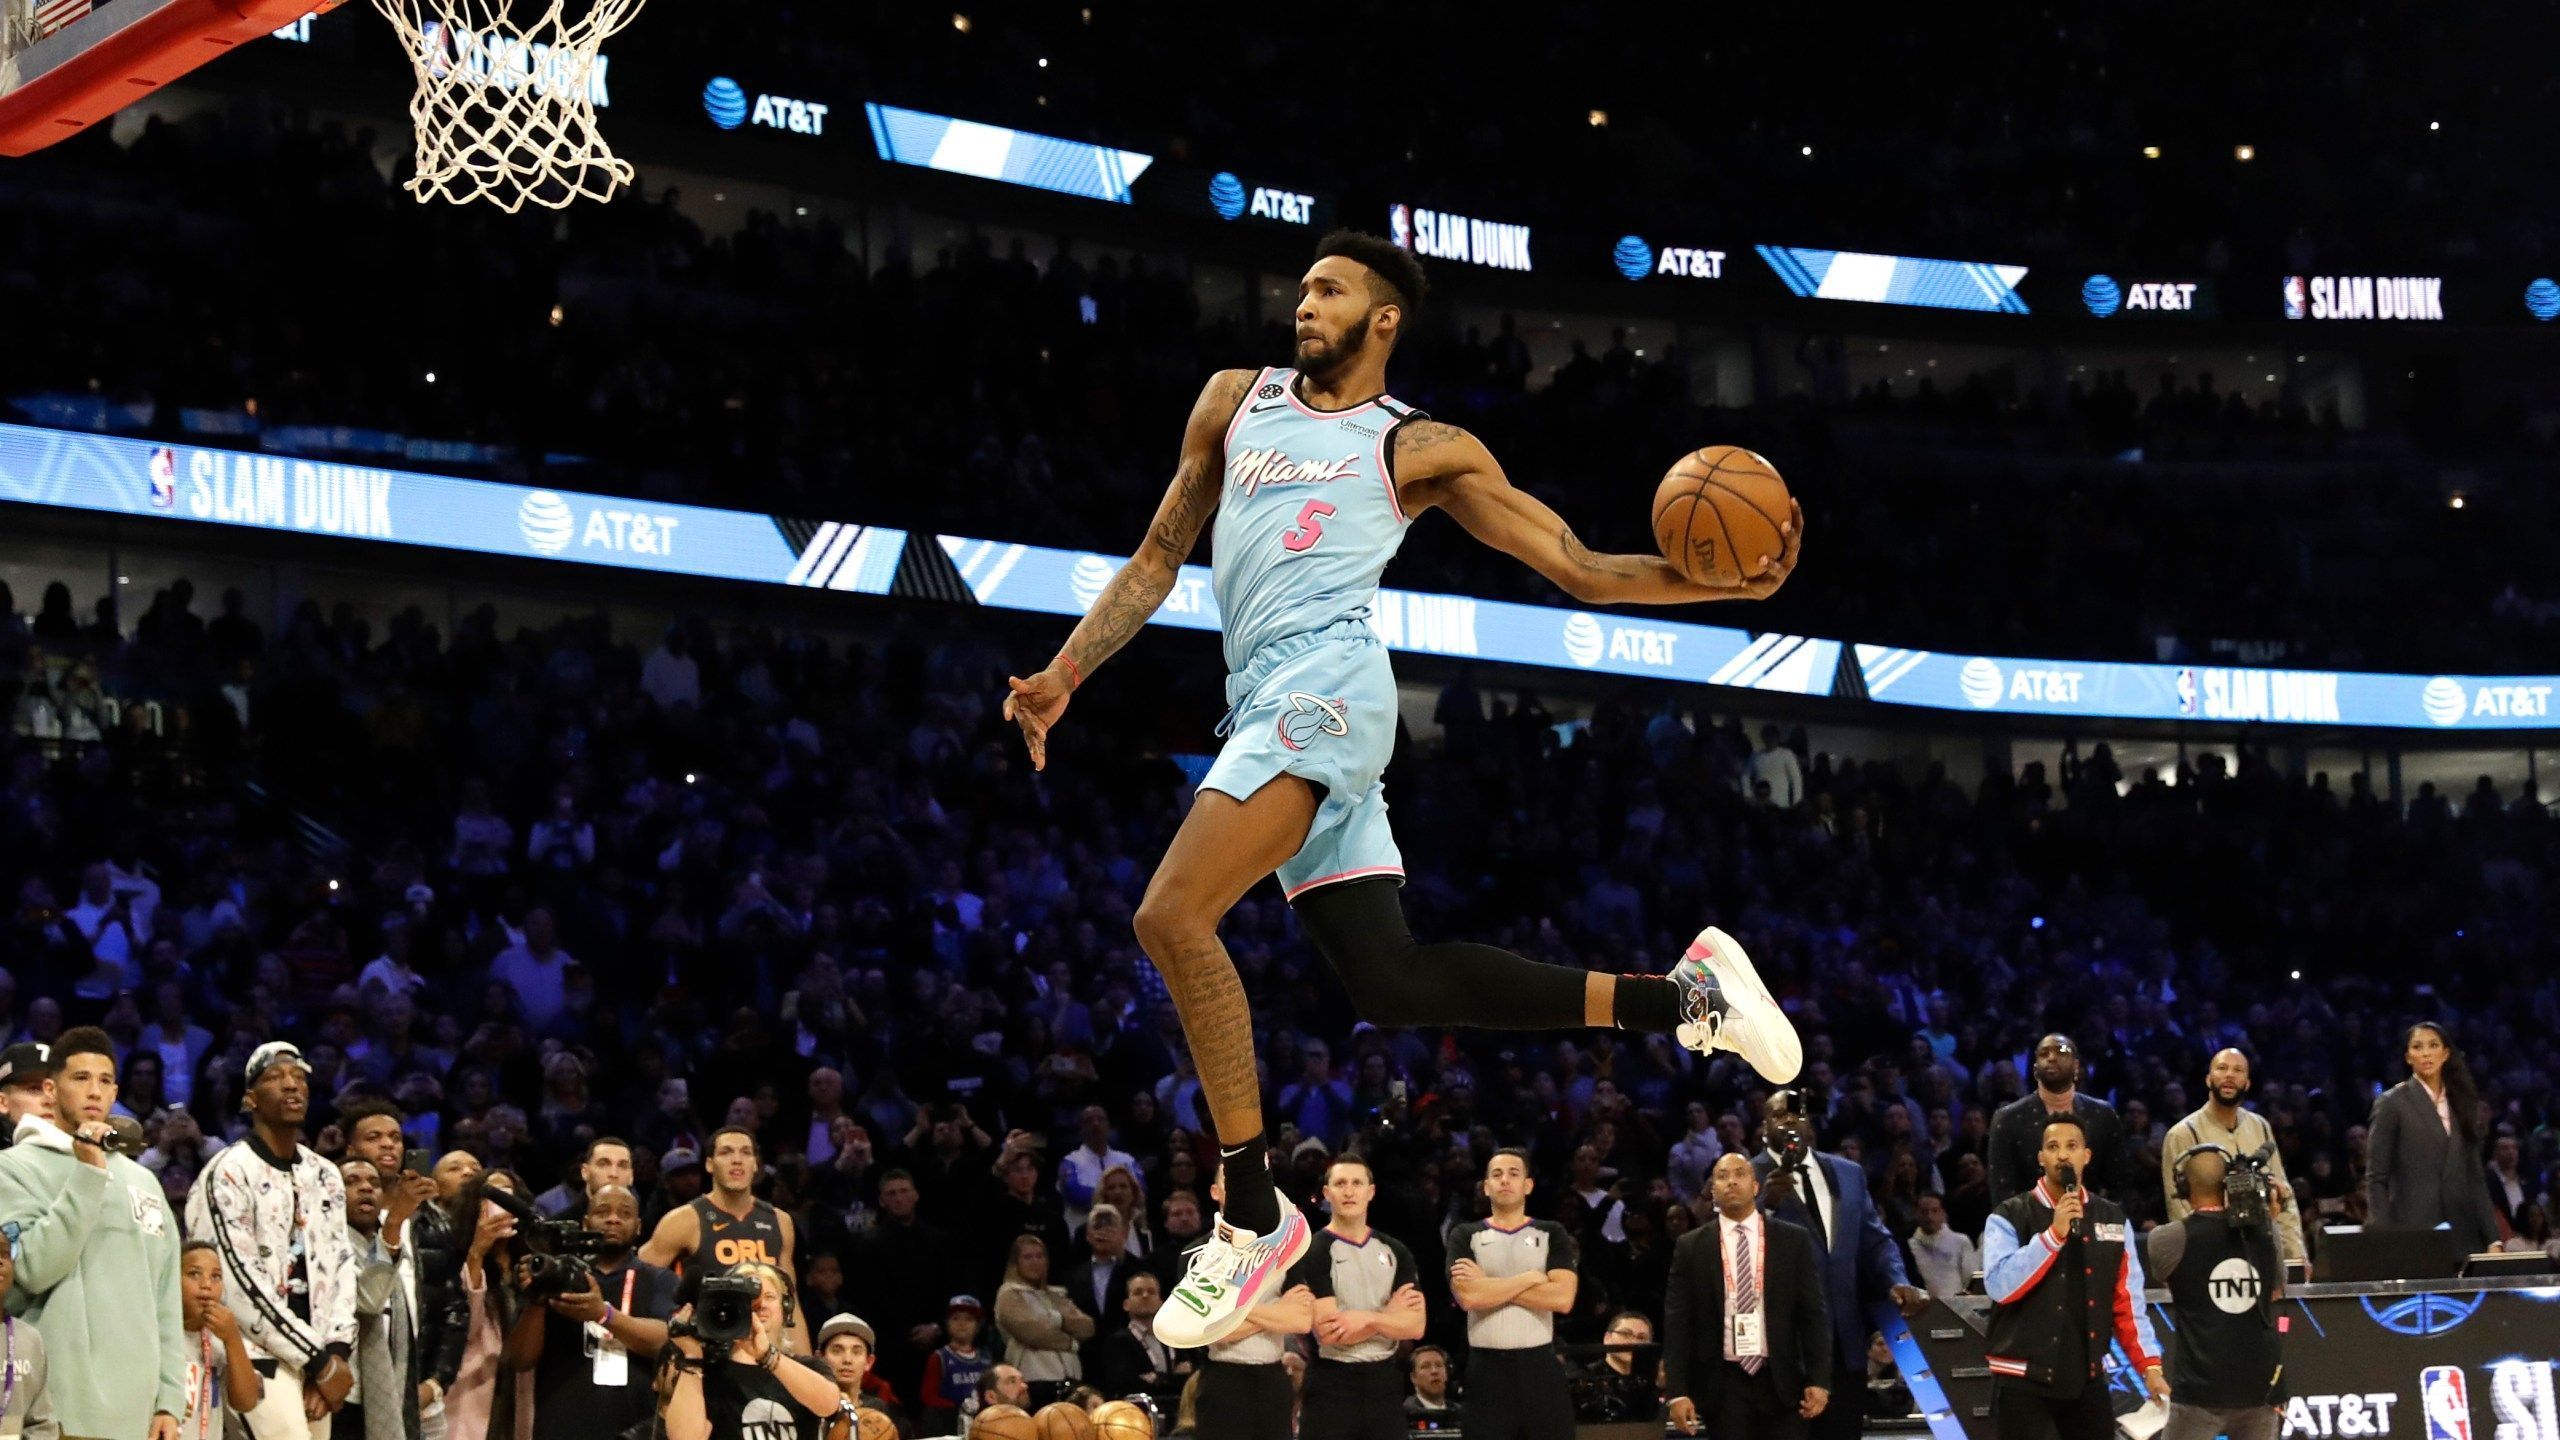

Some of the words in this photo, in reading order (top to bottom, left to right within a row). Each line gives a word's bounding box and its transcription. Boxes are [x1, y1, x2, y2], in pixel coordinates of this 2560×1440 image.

[751, 93, 828, 136] AT&T
[1250, 187, 1315, 225] AT&T
[1413, 207, 1470, 263] SLAM
[1470, 218, 1533, 272] DUNK
[1657, 246, 1727, 279] AT&T
[2125, 283, 2198, 311] AT&T
[2309, 276, 2375, 320] SLAM
[2376, 276, 2444, 321] DUNK
[188, 450, 286, 527] SLAM
[293, 461, 394, 538] DUNK
[1229, 447, 1360, 498] Miami
[582, 508, 680, 556] AT&T
[1282, 499, 1337, 555] 5
[1407, 593, 1479, 656] DUNK
[1608, 626, 1679, 667] AT&T
[2009, 667, 2085, 704] AT&T
[2203, 668, 2269, 720] SLAM
[2271, 671, 2341, 722] DUNK
[2472, 685, 2553, 717] AT&T
[714, 1238, 777, 1266] ORL
[2208, 1277, 2261, 1299] TNT
[2281, 1392, 2398, 1439] AT&T
